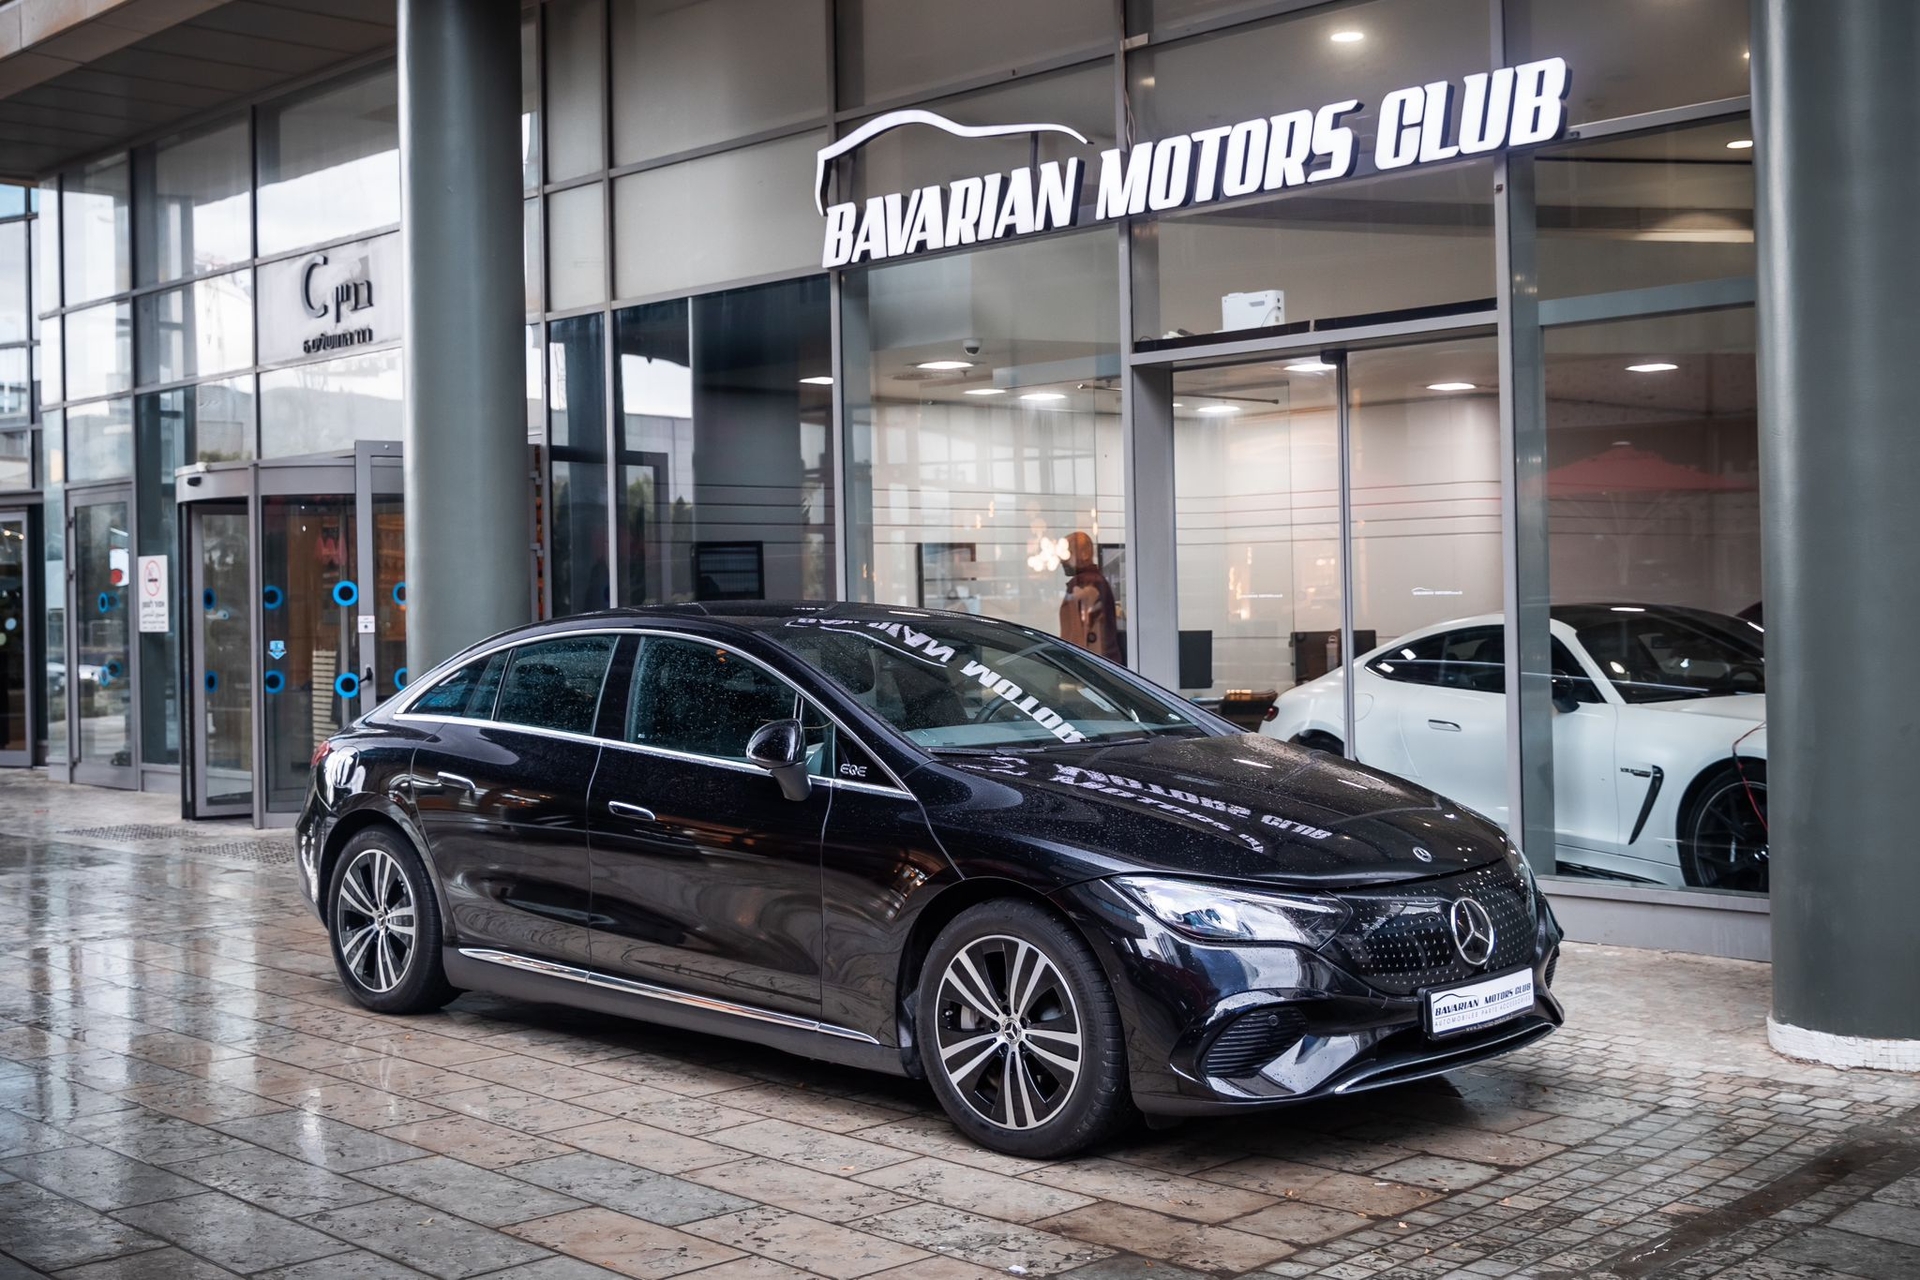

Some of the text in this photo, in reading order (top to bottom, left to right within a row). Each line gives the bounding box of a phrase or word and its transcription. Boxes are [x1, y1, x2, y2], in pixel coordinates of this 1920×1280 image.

[822, 57, 1571, 268] BAVARIAN MOTORS CLUB
[300, 254, 328, 319] C
[840, 763, 867, 777] EQE
[1435, 983, 1531, 1016] BAVARIAN MOTORS CLUB
